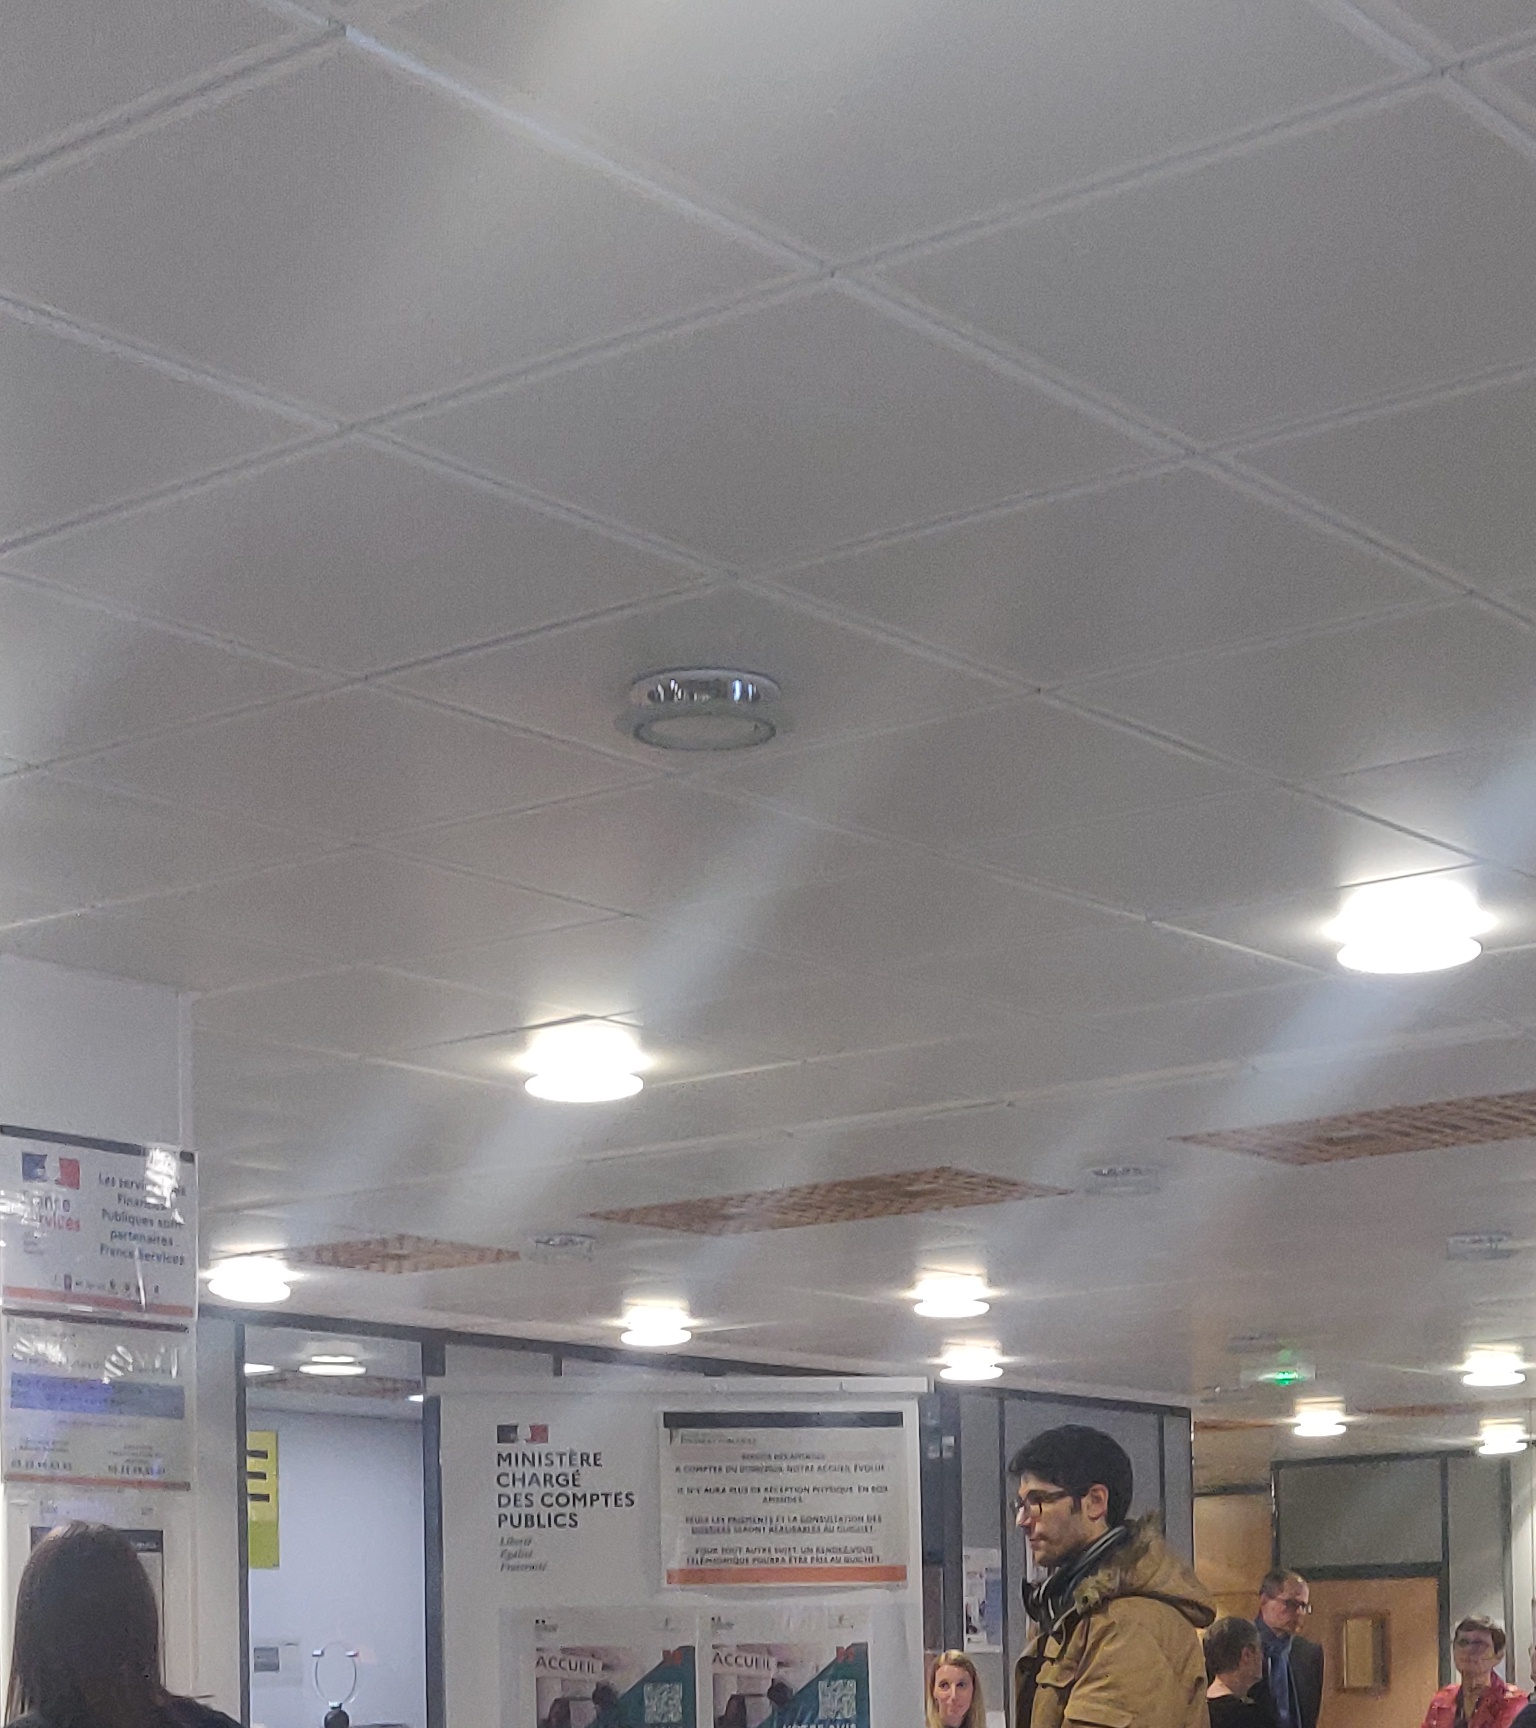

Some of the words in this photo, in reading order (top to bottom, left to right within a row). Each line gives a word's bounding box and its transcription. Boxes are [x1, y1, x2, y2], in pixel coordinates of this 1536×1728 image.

[102, 1208, 154, 1227] Publiques
[497, 1448, 602, 1467] MINISTÈRE
[496, 1469, 581, 1488] CHARGÉ
[498, 1493, 534, 1508] DES
[540, 1491, 635, 1508] COMPTES
[498, 1512, 578, 1529] PUBLICS
[536, 1656, 596, 1674] ACCUEIL
[712, 1652, 771, 1671] ACCUEIL
